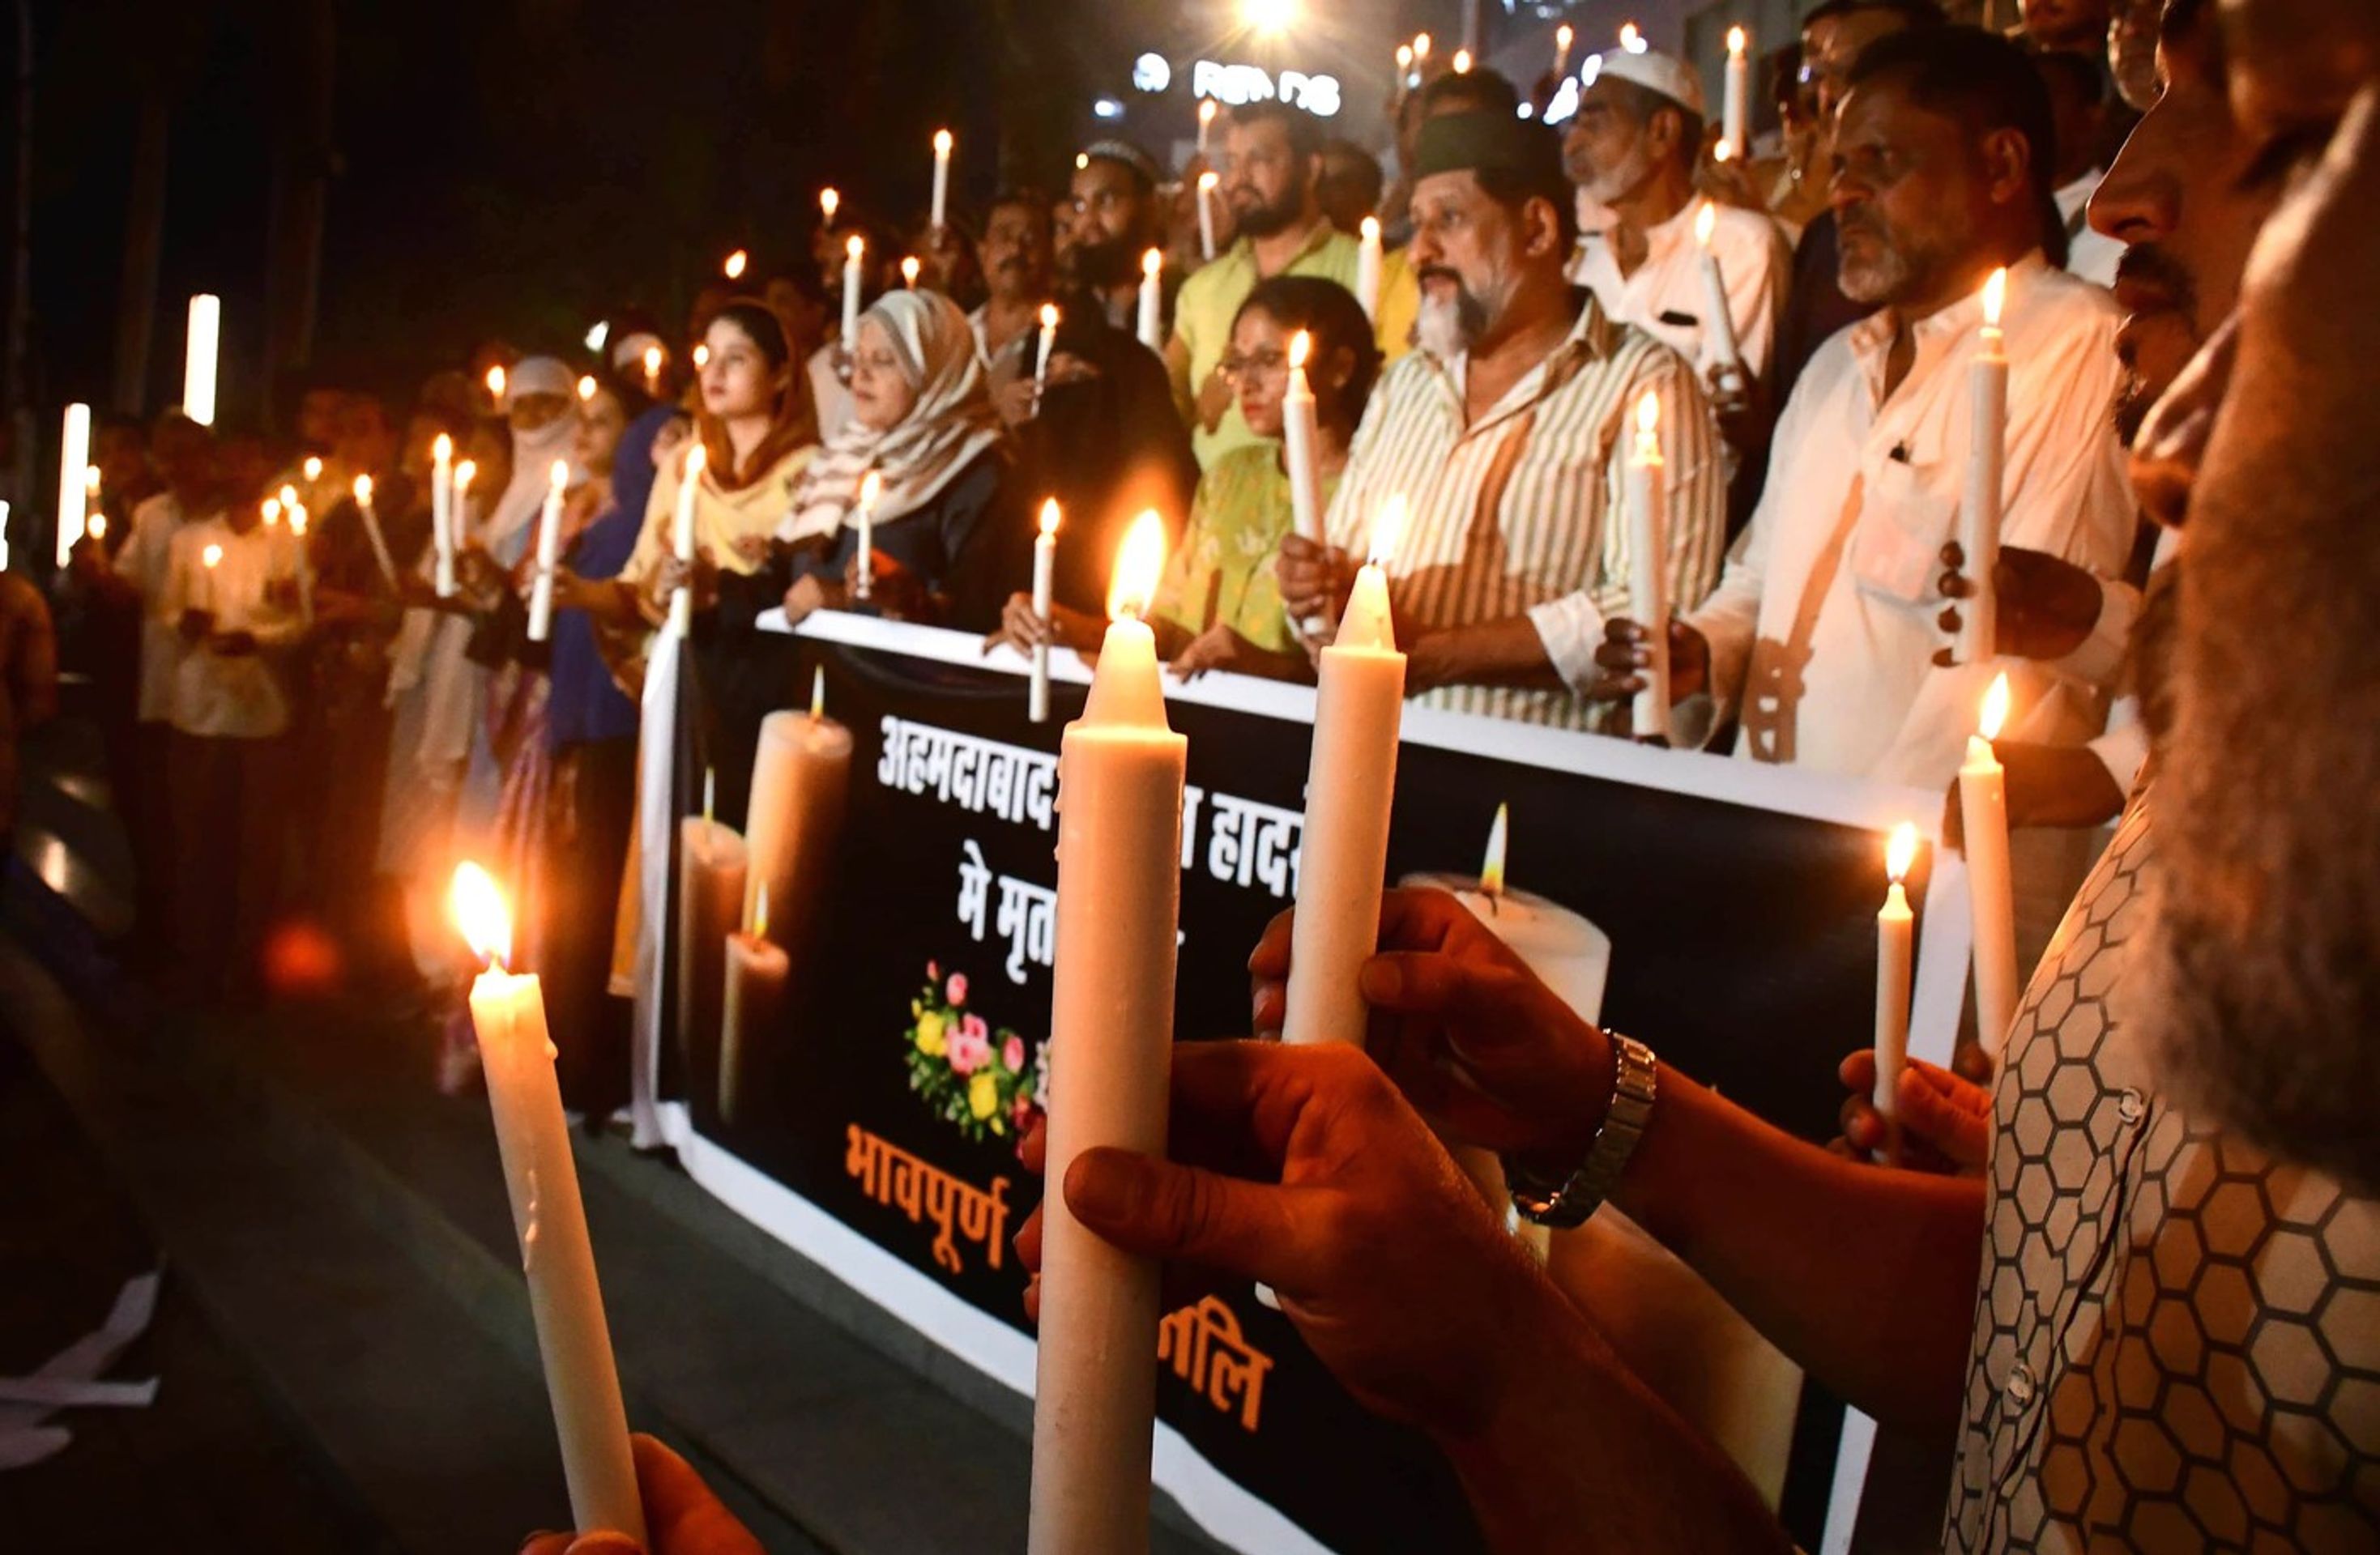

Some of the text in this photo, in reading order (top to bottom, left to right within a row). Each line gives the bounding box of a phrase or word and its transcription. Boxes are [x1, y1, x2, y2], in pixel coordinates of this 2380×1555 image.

[878, 716, 1059, 830] अहमदाबाद
[958, 838, 992, 942] मे
[847, 1123, 1009, 1273] भावपूर्ण
